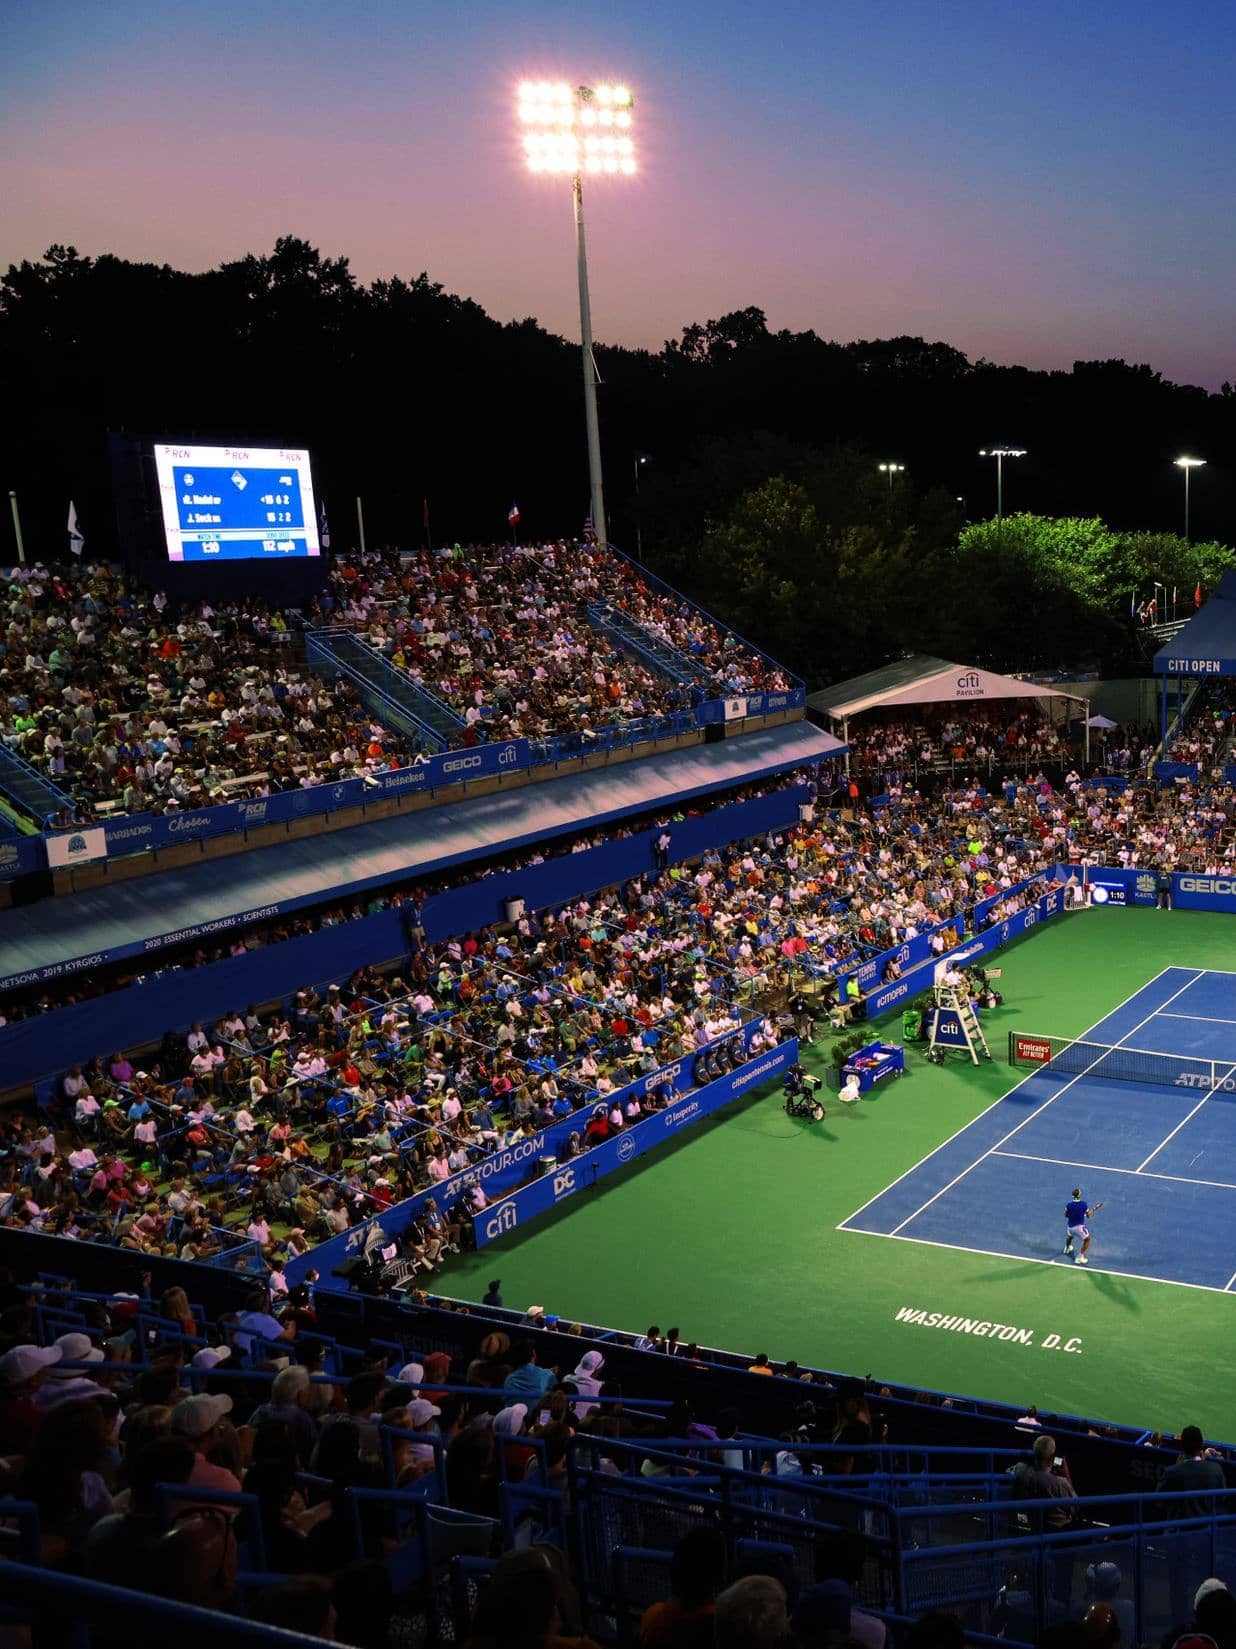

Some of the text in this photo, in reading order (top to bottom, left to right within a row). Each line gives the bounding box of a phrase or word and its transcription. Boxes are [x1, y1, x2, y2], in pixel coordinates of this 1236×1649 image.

[1168, 659, 1221, 673] CITI OPEN
[957, 673, 979, 688] citi
[956, 688, 985, 697] PAVILION
[443, 755, 481, 773] GEICO
[498, 746, 517, 764] citi
[385, 771, 425, 789] Heineken
[1110, 890, 1125, 899] 1:10
[145, 905, 279, 950] 2020 ESSENTIAL WORKERS SCIENTISTS
[43, 965, 62, 978] 2019
[65, 954, 102, 972] KYRGIOS
[876, 983, 908, 1009] #CITIOPEN
[940, 1023, 958, 1035] citi
[1018, 1042, 1050, 1053] Emirates
[645, 1063, 681, 1090] GEICO
[1173, 1072, 1211, 1088] ATP
[553, 1169, 576, 1196] DC
[486, 1203, 518, 1239] citi
[895, 1306, 1083, 1354] WASHINGTON, D.C.
